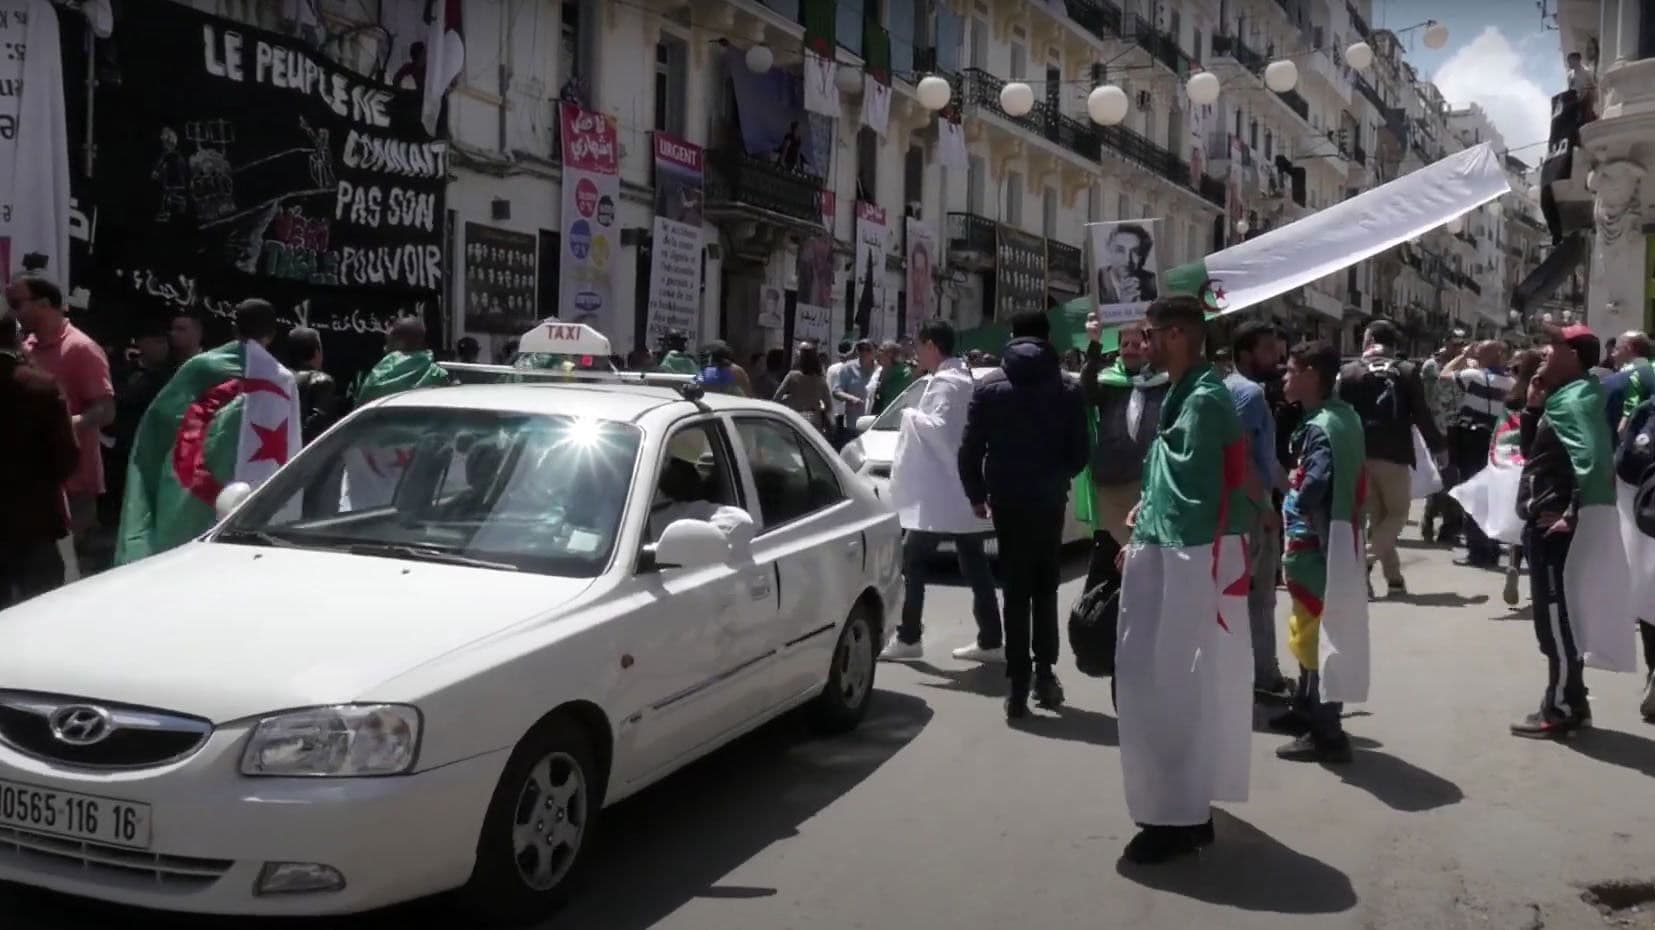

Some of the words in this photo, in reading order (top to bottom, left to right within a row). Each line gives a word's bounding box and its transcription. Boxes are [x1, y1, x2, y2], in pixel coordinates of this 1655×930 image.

[202, 23, 245, 83] LE
[255, 40, 350, 118] PEUPLE
[351, 84, 396, 128] NE
[659, 138, 697, 166] URGENT
[335, 180, 382, 228] PAS
[387, 187, 436, 232] SON
[340, 243, 442, 290] POUVOIR
[545, 325, 582, 340] TAXI
[113, 805, 136, 840] 16
